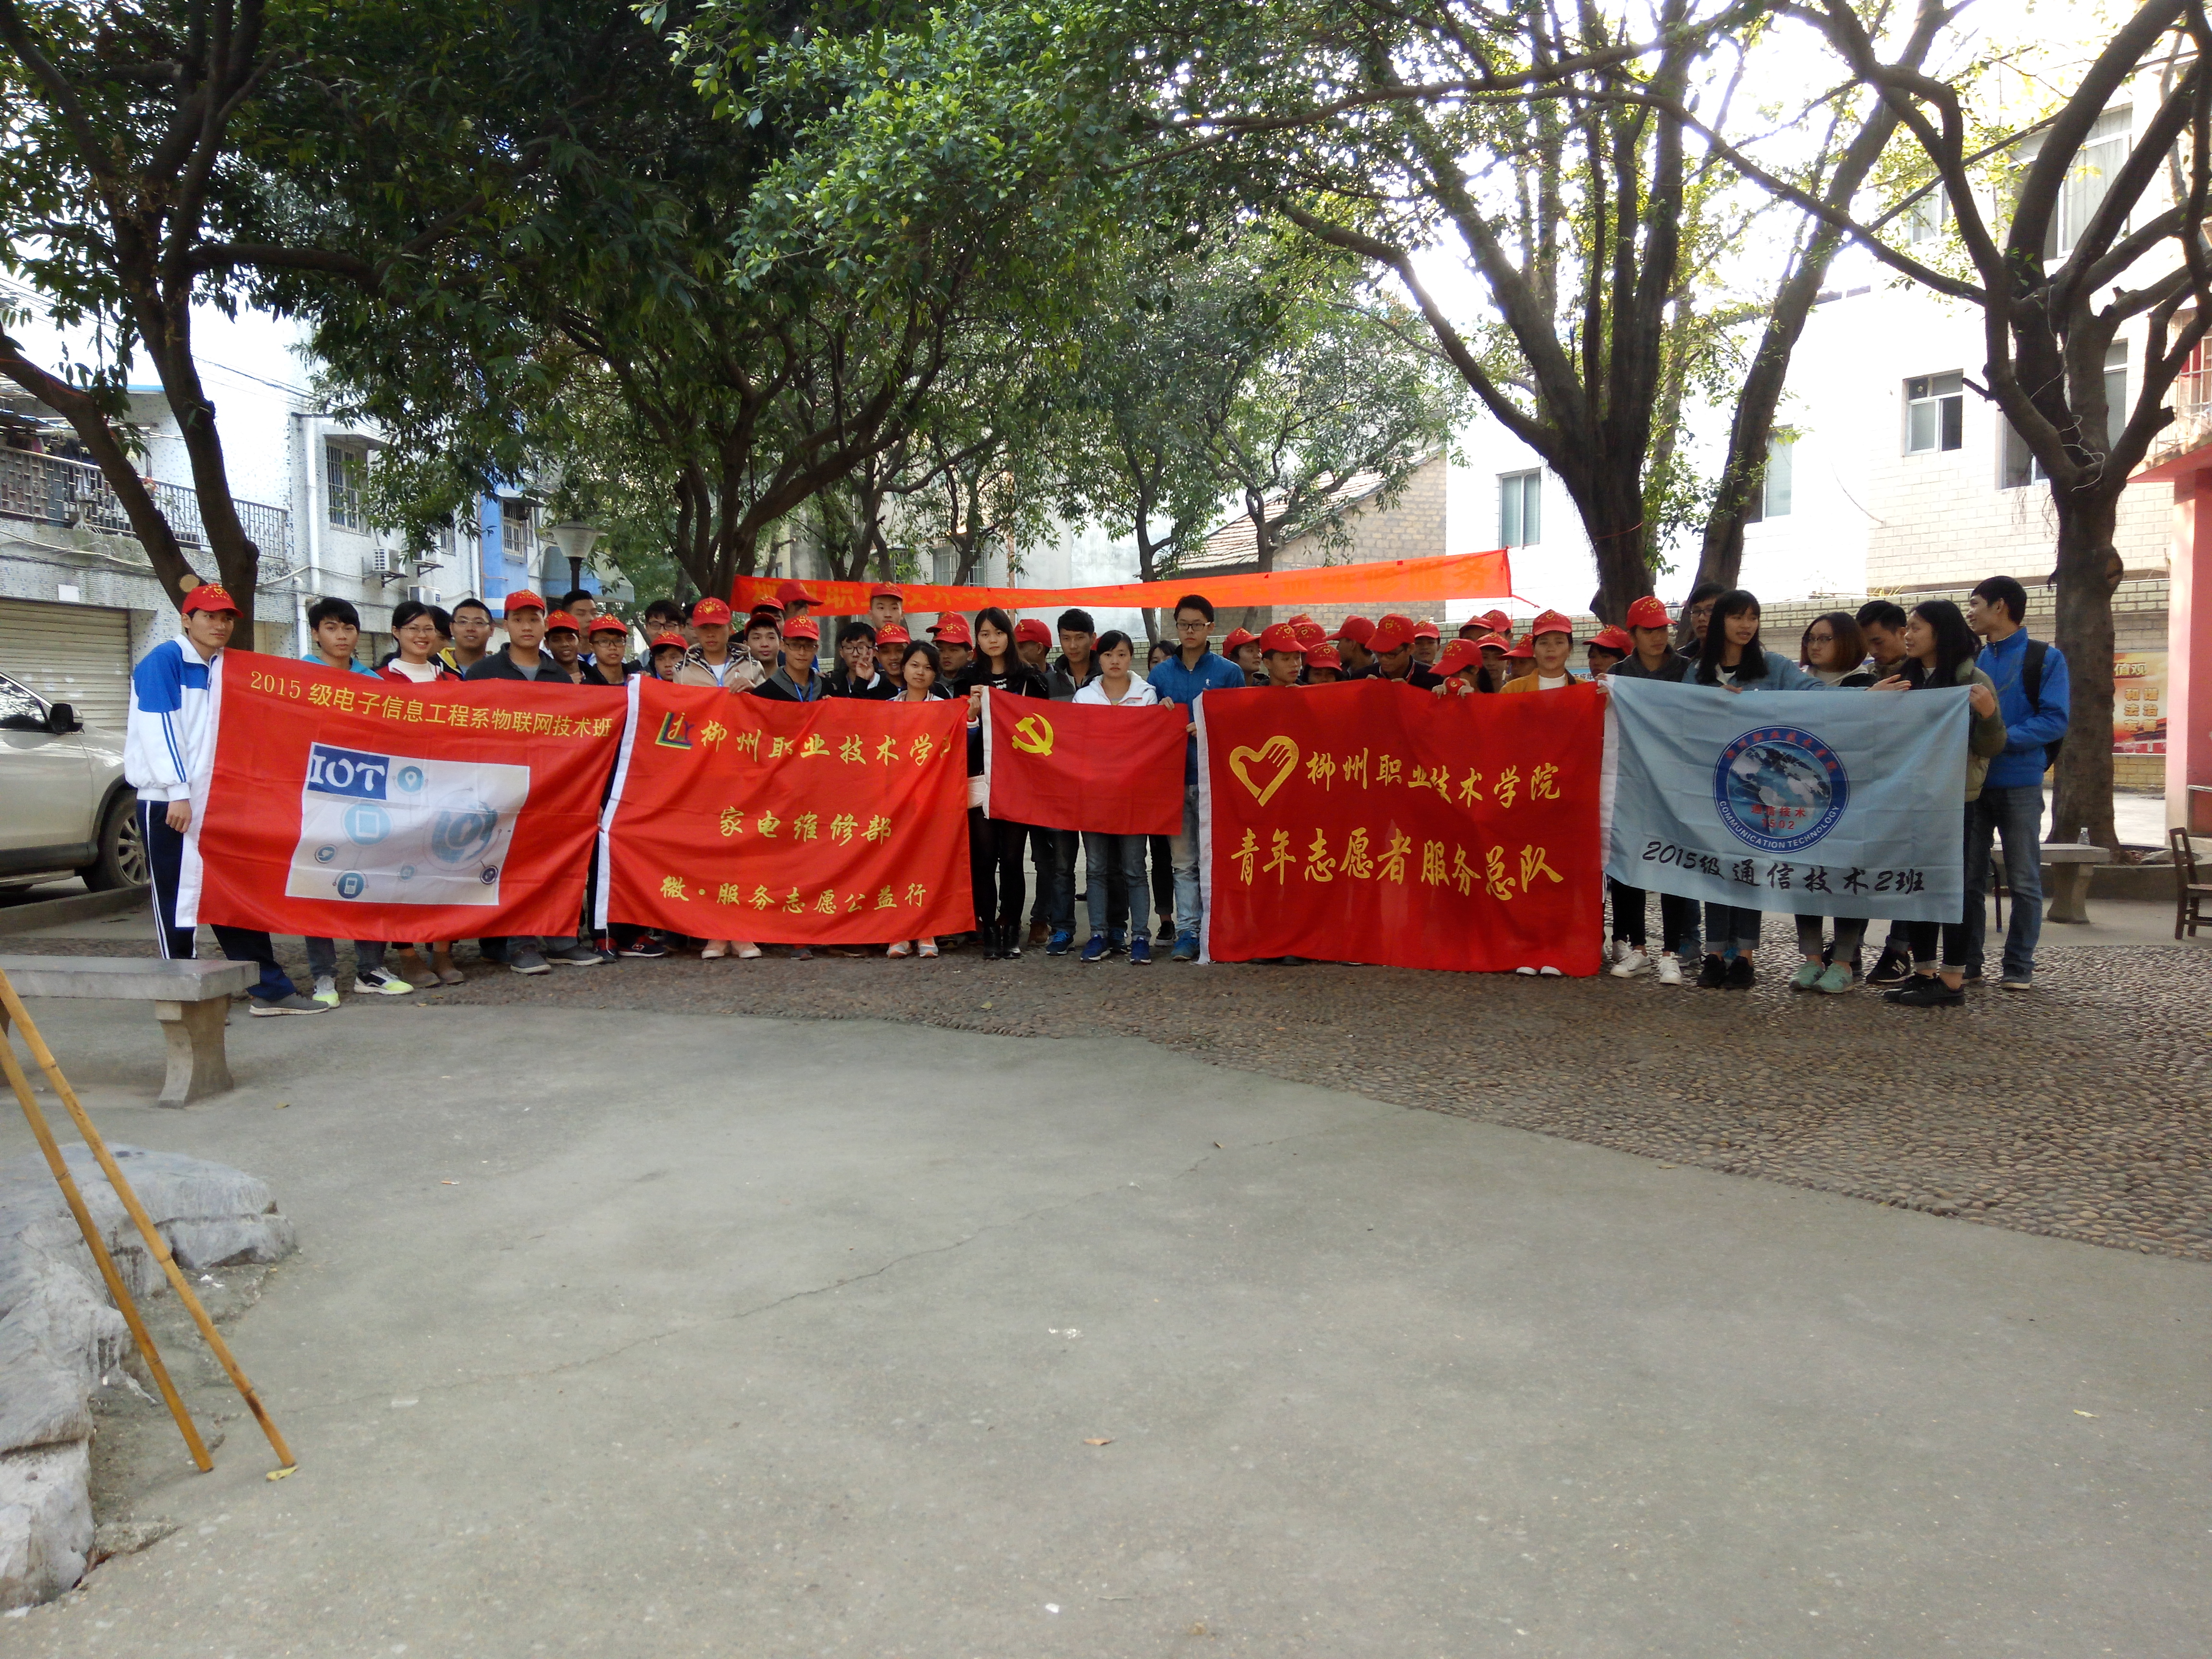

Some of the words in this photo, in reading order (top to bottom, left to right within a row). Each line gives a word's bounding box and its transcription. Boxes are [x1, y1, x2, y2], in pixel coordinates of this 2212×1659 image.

[2114, 663, 2147, 676] 值观
[250, 671, 301, 699] 2015
[308, 684, 613, 738] 级电子信息工程系物联网技术班
[2124, 704, 2158, 716] 法治
[2125, 688, 2159, 701] 和谐
[2124, 720, 2157, 732] 友善
[311, 753, 385, 792] IOT
[1306, 747, 1561, 809] 柳州职业技术学院
[720, 805, 892, 846] 家电维修部
[1719, 800, 1786, 849] COMMUNICATION
[1788, 805, 1840, 848] TECHNOLOGY
[1751, 804, 1806, 818] 通信技术
[1762, 817, 1795, 830] 1502
[1231, 827, 1564, 901] 青年志愿者服务总队
[1642, 841, 1925, 895] 2015级通信技术2班
